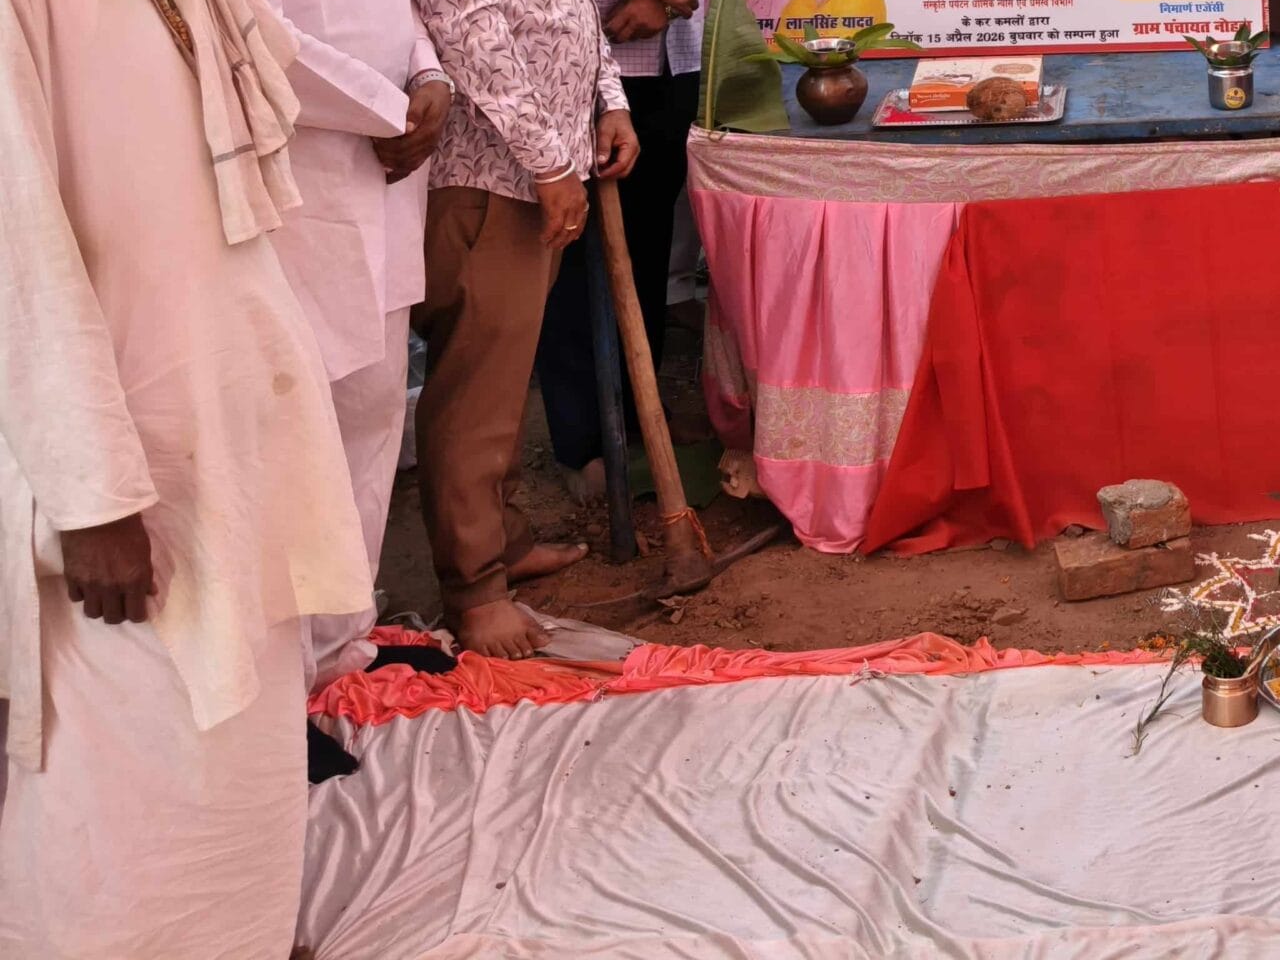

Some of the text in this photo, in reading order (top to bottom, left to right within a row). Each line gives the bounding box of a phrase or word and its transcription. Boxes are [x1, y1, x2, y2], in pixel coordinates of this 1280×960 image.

[841, 16, 874, 28] यादव
[960, 16, 971, 27] के
[975, 18, 991, 26] कर
[1028, 16, 1050, 26] द्वारा
[1132, 22, 1161, 35] ग्राम
[1164, 18, 1210, 34] पंचायत
[927, 34, 942, 43] 15
[946, 29, 973, 42] अप्रैल
[976, 32, 1005, 42] 2026
[1047, 28, 1060, 40] को
[1064, 30, 1096, 39] सम्पन्न
[1099, 30, 1119, 42] हुआ
